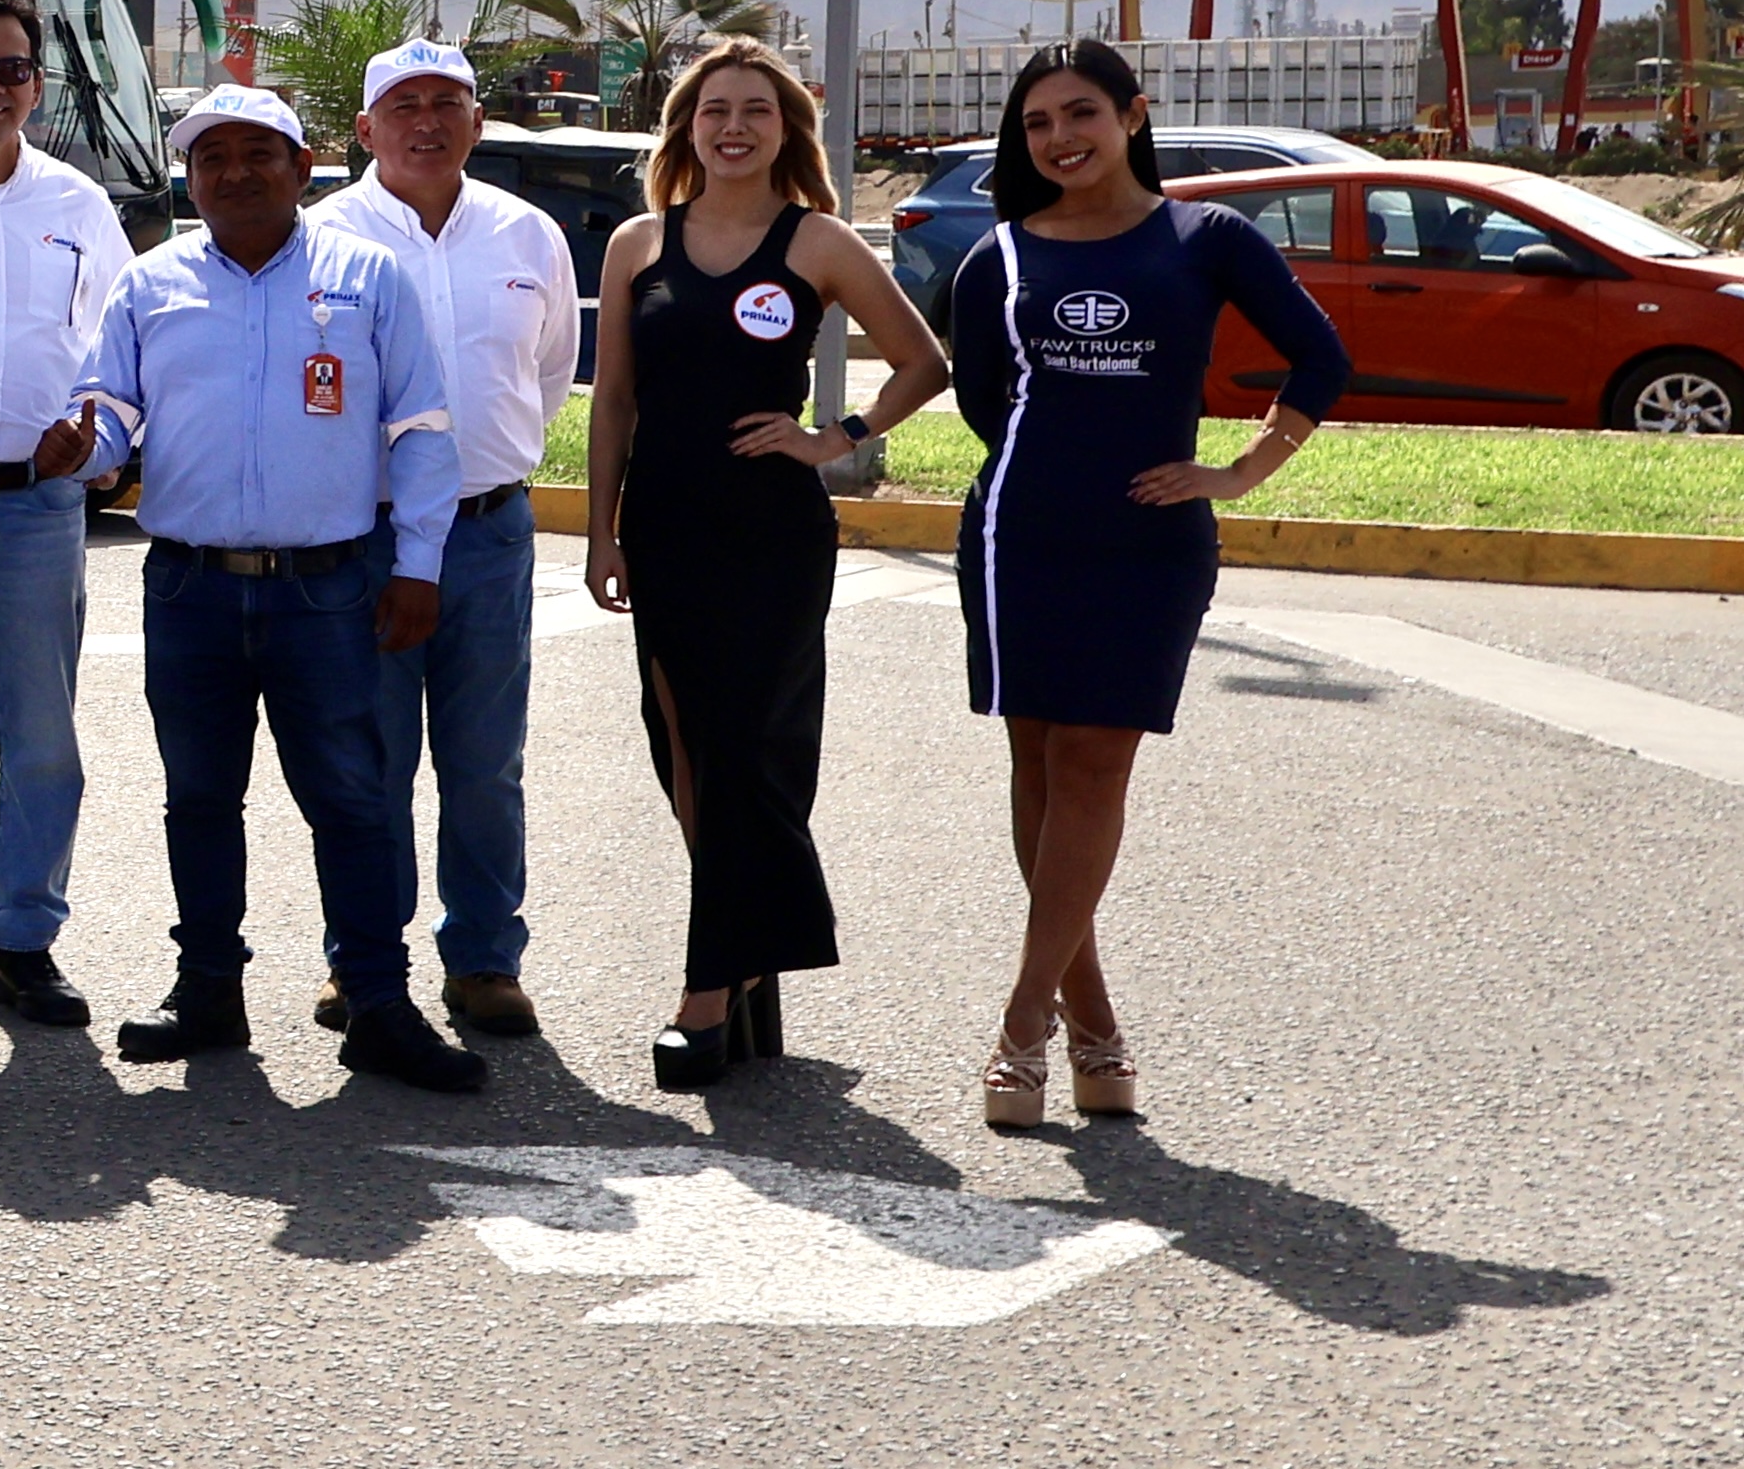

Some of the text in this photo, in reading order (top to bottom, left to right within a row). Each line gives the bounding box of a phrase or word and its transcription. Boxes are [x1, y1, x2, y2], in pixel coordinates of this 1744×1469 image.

[395, 48, 441, 66] GNV
[537, 99, 557, 111] CAT
[323, 293, 361, 301] PRIMAX
[741, 310, 788, 327] PRIMAX
[1030, 338, 1156, 353] FAW TRUCKS
[1043, 353, 1143, 371] San Bartolomé
